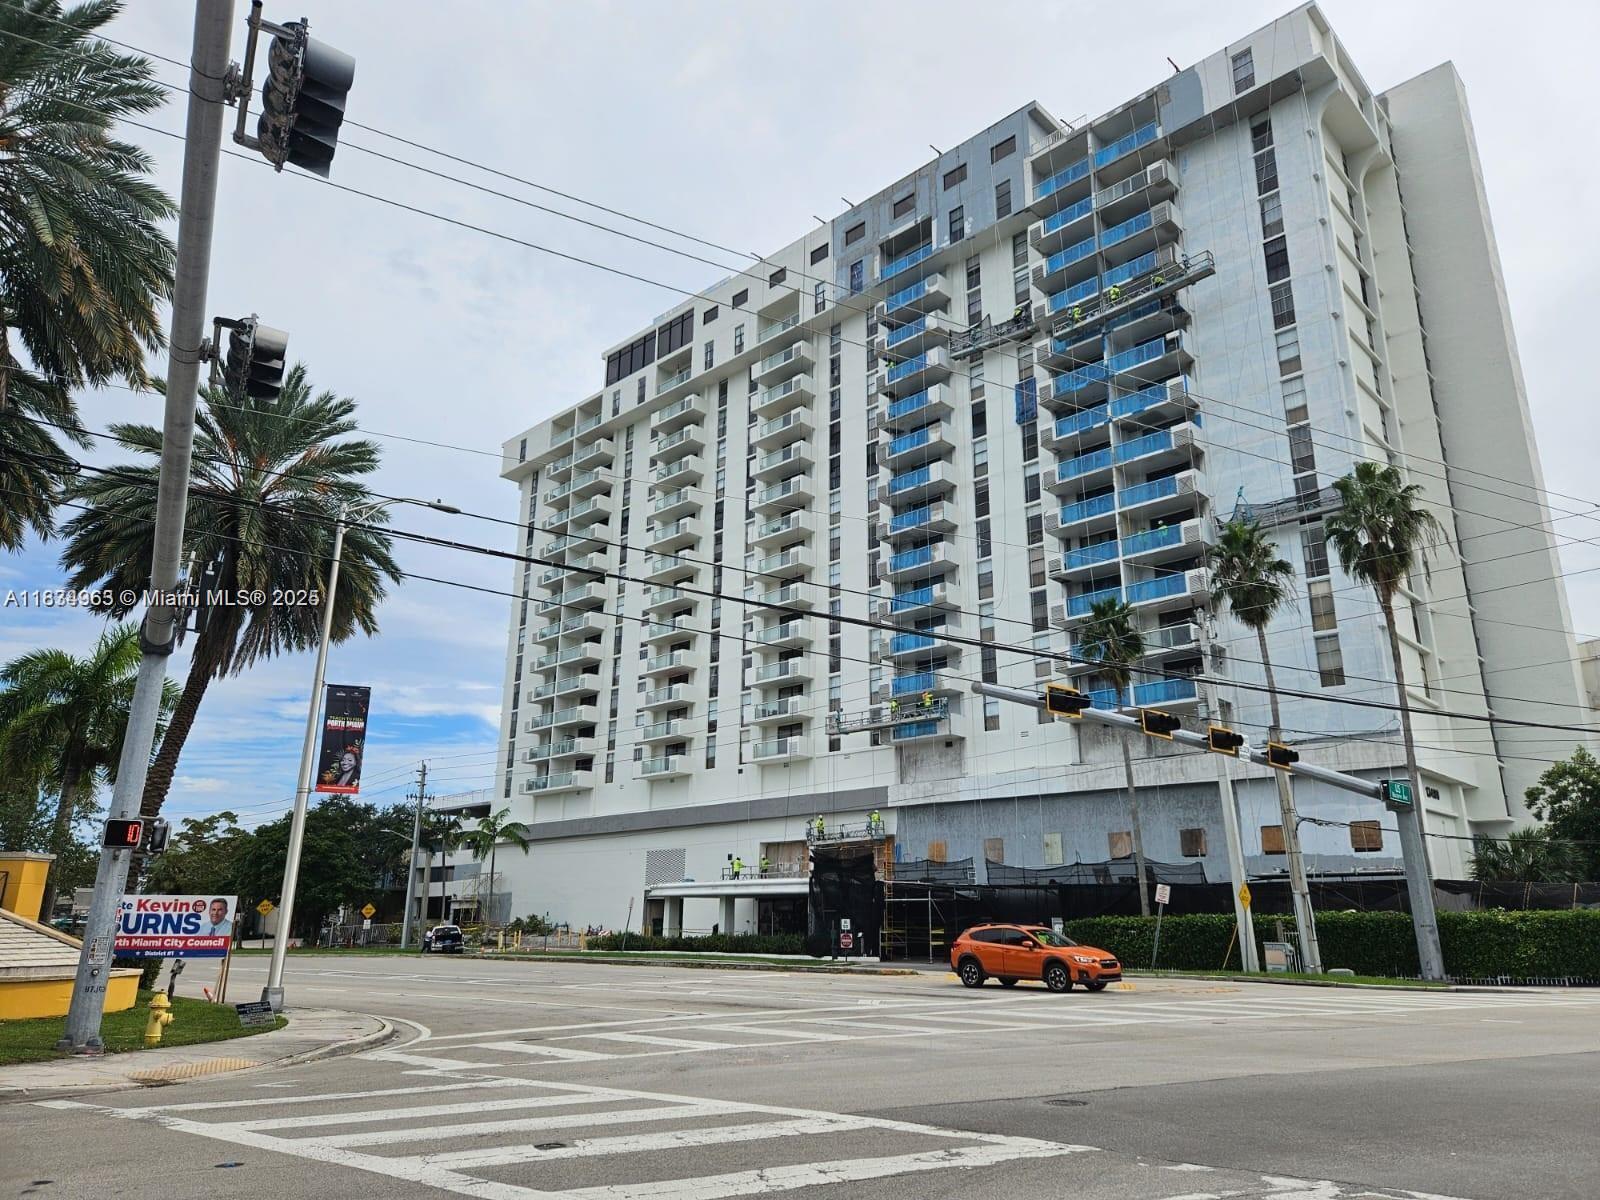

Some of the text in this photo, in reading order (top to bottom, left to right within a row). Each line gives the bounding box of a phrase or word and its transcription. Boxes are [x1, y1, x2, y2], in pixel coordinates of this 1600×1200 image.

[127, 824, 140, 843] 10
[119, 899, 133, 910] te
[136, 898, 190, 912] Kevin
[114, 938, 224, 948] rth Miami City Council
